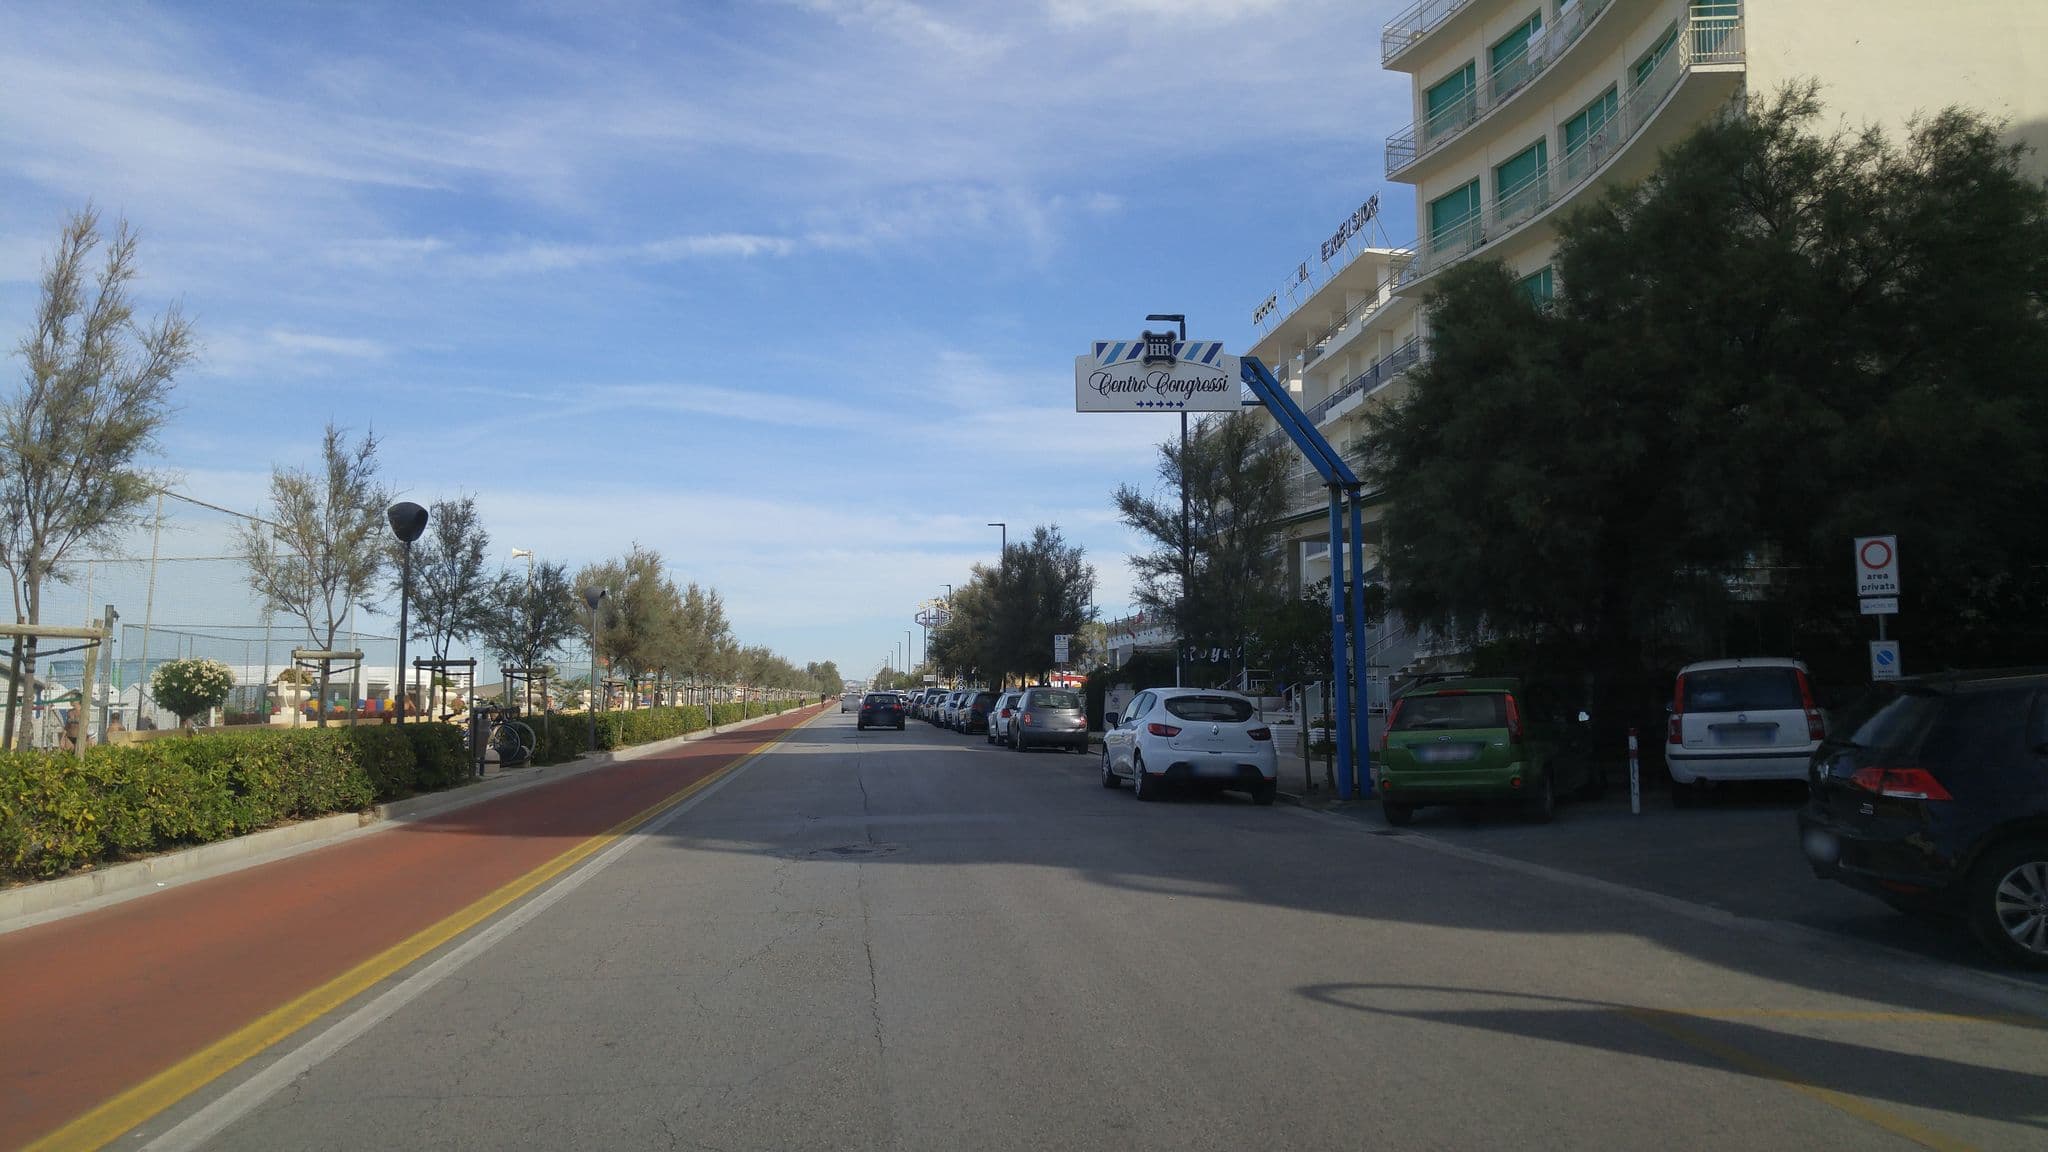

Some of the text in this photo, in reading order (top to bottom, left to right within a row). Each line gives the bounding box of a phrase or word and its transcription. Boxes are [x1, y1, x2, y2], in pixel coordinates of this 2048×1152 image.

[1148, 343, 1171, 356] HR
[1089, 371, 1230, 400] Centro Congressi
[1861, 583, 1896, 592] privata
